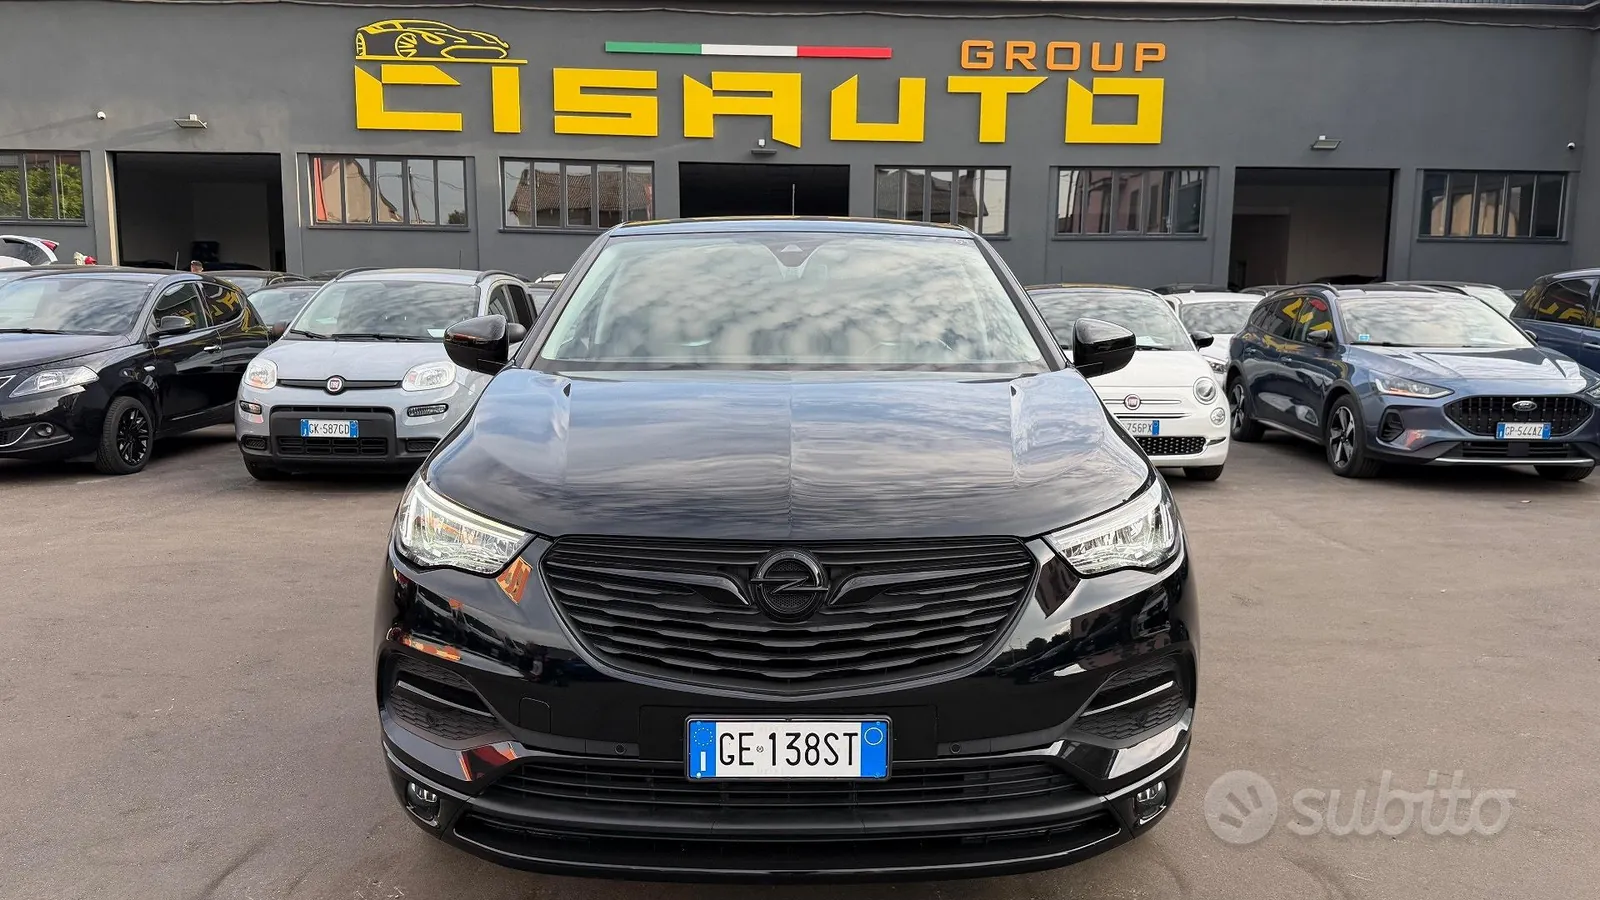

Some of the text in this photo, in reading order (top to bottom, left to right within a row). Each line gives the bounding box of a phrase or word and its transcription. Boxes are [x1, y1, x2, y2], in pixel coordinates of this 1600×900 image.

[960, 39, 1166, 72] GROUP
[354, 64, 1165, 149] CISAUTO
[719, 732, 859, 766] GE 138ST
